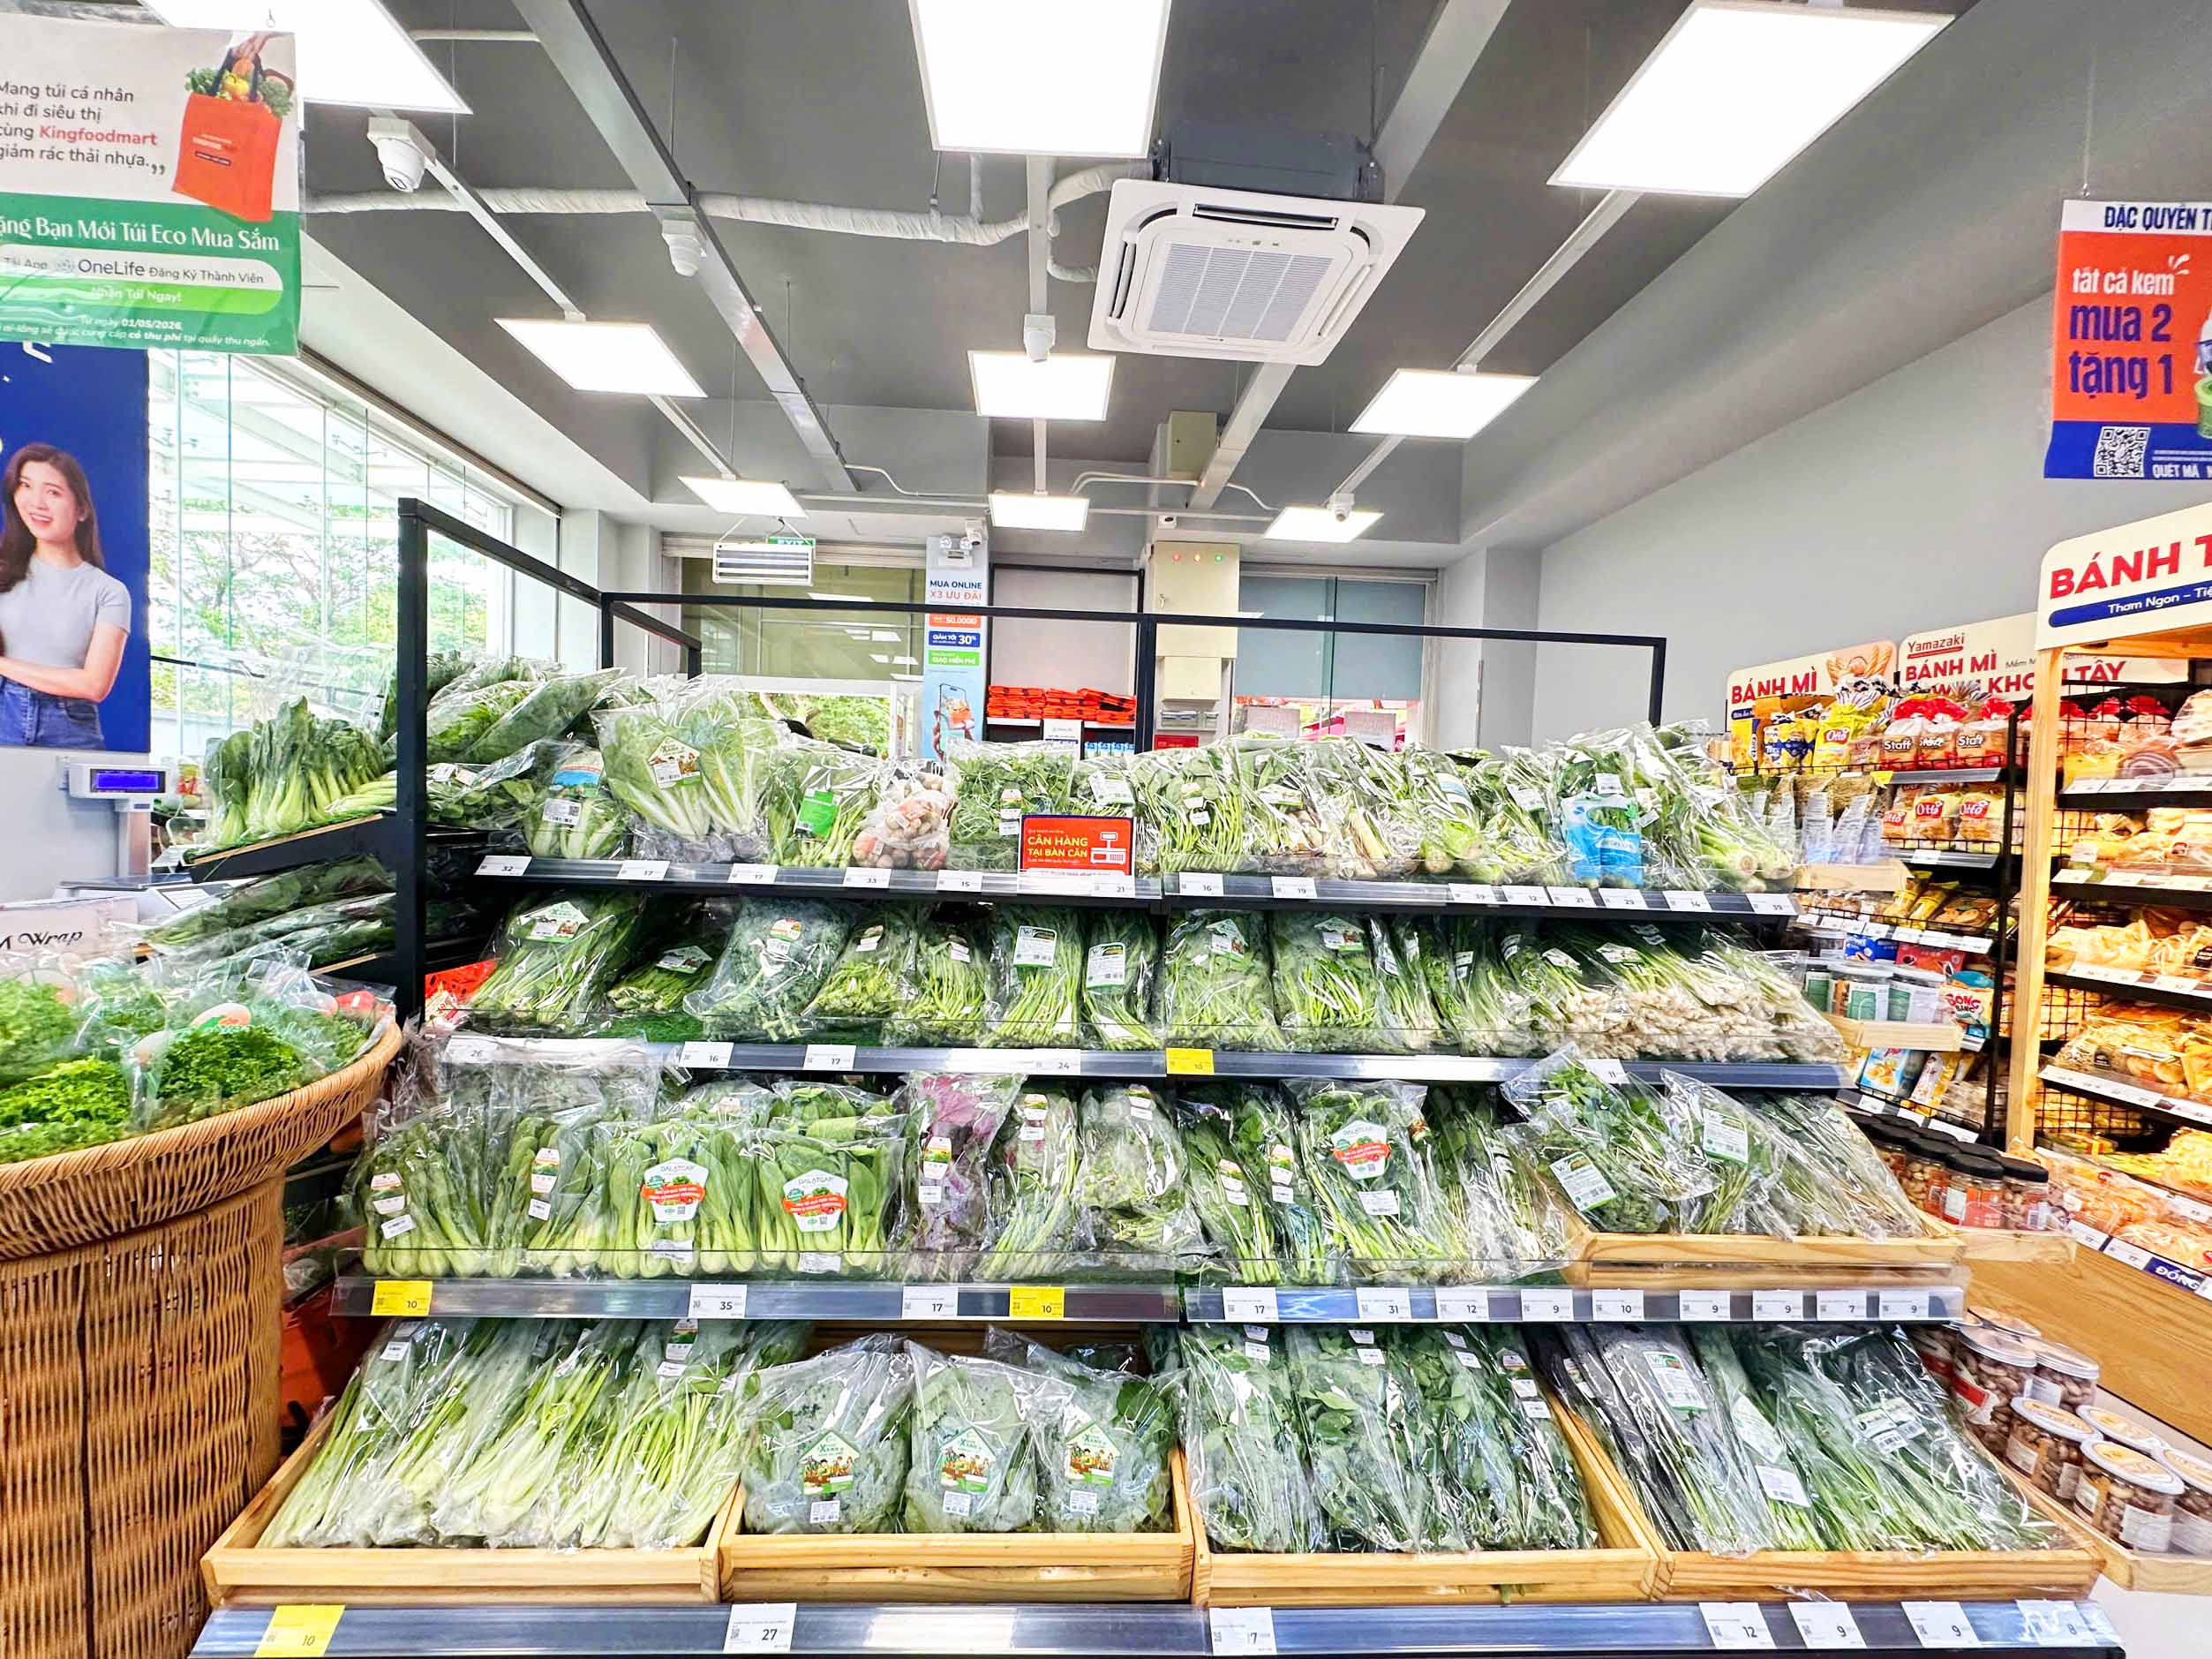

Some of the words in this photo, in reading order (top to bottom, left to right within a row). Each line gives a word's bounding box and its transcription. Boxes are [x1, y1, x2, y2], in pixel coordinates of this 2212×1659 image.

[46, 84, 66, 98] túi
[71, 86, 88, 99] cá
[94, 87, 134, 102] nhân
[24, 103, 38, 117] đi
[44, 104, 75, 119] siêu
[81, 107, 102, 124] thị
[40, 125, 158, 146] Kingfoodmart
[40, 146, 64, 161] rác
[69, 147, 99, 163] thải
[36, 217, 72, 240] Bạn
[78, 219, 116, 241] Mới
[120, 222, 147, 243] Túi
[152, 224, 186, 245] Eco
[192, 227, 233, 248] Mua
[237, 228, 279, 252] Sắm
[79, 259, 145, 276] OneLife
[200, 269, 235, 282] Thành
[2103, 267, 2128, 295] cả
[2132, 268, 2175, 296] kem
[2070, 304, 2142, 342] mua
[2151, 303, 2171, 342] 2
[2069, 351, 2148, 400] tặng
[2158, 354, 2173, 395] 1
[2050, 541, 2181, 600] BÁNH
[952, 581, 982, 590] ONLINE
[2146, 594, 2180, 608] Ngon
[1907, 632, 1966, 652] Yamazaki
[1906, 657, 1964, 682] BÁNH
[1970, 649, 1998, 674] MÌ
[1731, 677, 1786, 705] BÁNH
[1792, 666, 1817, 694] MÌ
[1885, 739, 1911, 750] Staff
[1027, 834, 1052, 846] CÂN
[1055, 835, 1088, 847] HÀNG
[1027, 848, 1042, 858] TẠI
[1044, 848, 1065, 857] BÀN
[18, 931, 83, 946] Wrap
[407, 1300, 418, 1308] 10
[719, 1301, 733, 1310] 35
[931, 1303, 943, 1312] 17
[1042, 1305, 1052, 1314] 10
[1254, 1305, 1265, 1315] 17
[1388, 1305, 1399, 1315] 31
[1466, 1305, 1477, 1314] 12
[1553, 1305, 1560, 1314] 9
[1621, 1305, 1632, 1314] 10
[1712, 1305, 1719, 1314] 9
[1785, 1305, 1792, 1314] 9
[1849, 1305, 1855, 1314] 7
[1911, 1305, 1917, 1314] 9
[762, 1629, 778, 1640] 27
[1742, 1625, 1757, 1639] 12
[1837, 1625, 1847, 1638] 9
[1952, 1625, 1961, 1637] 9
[302, 1634, 316, 1647] 10
